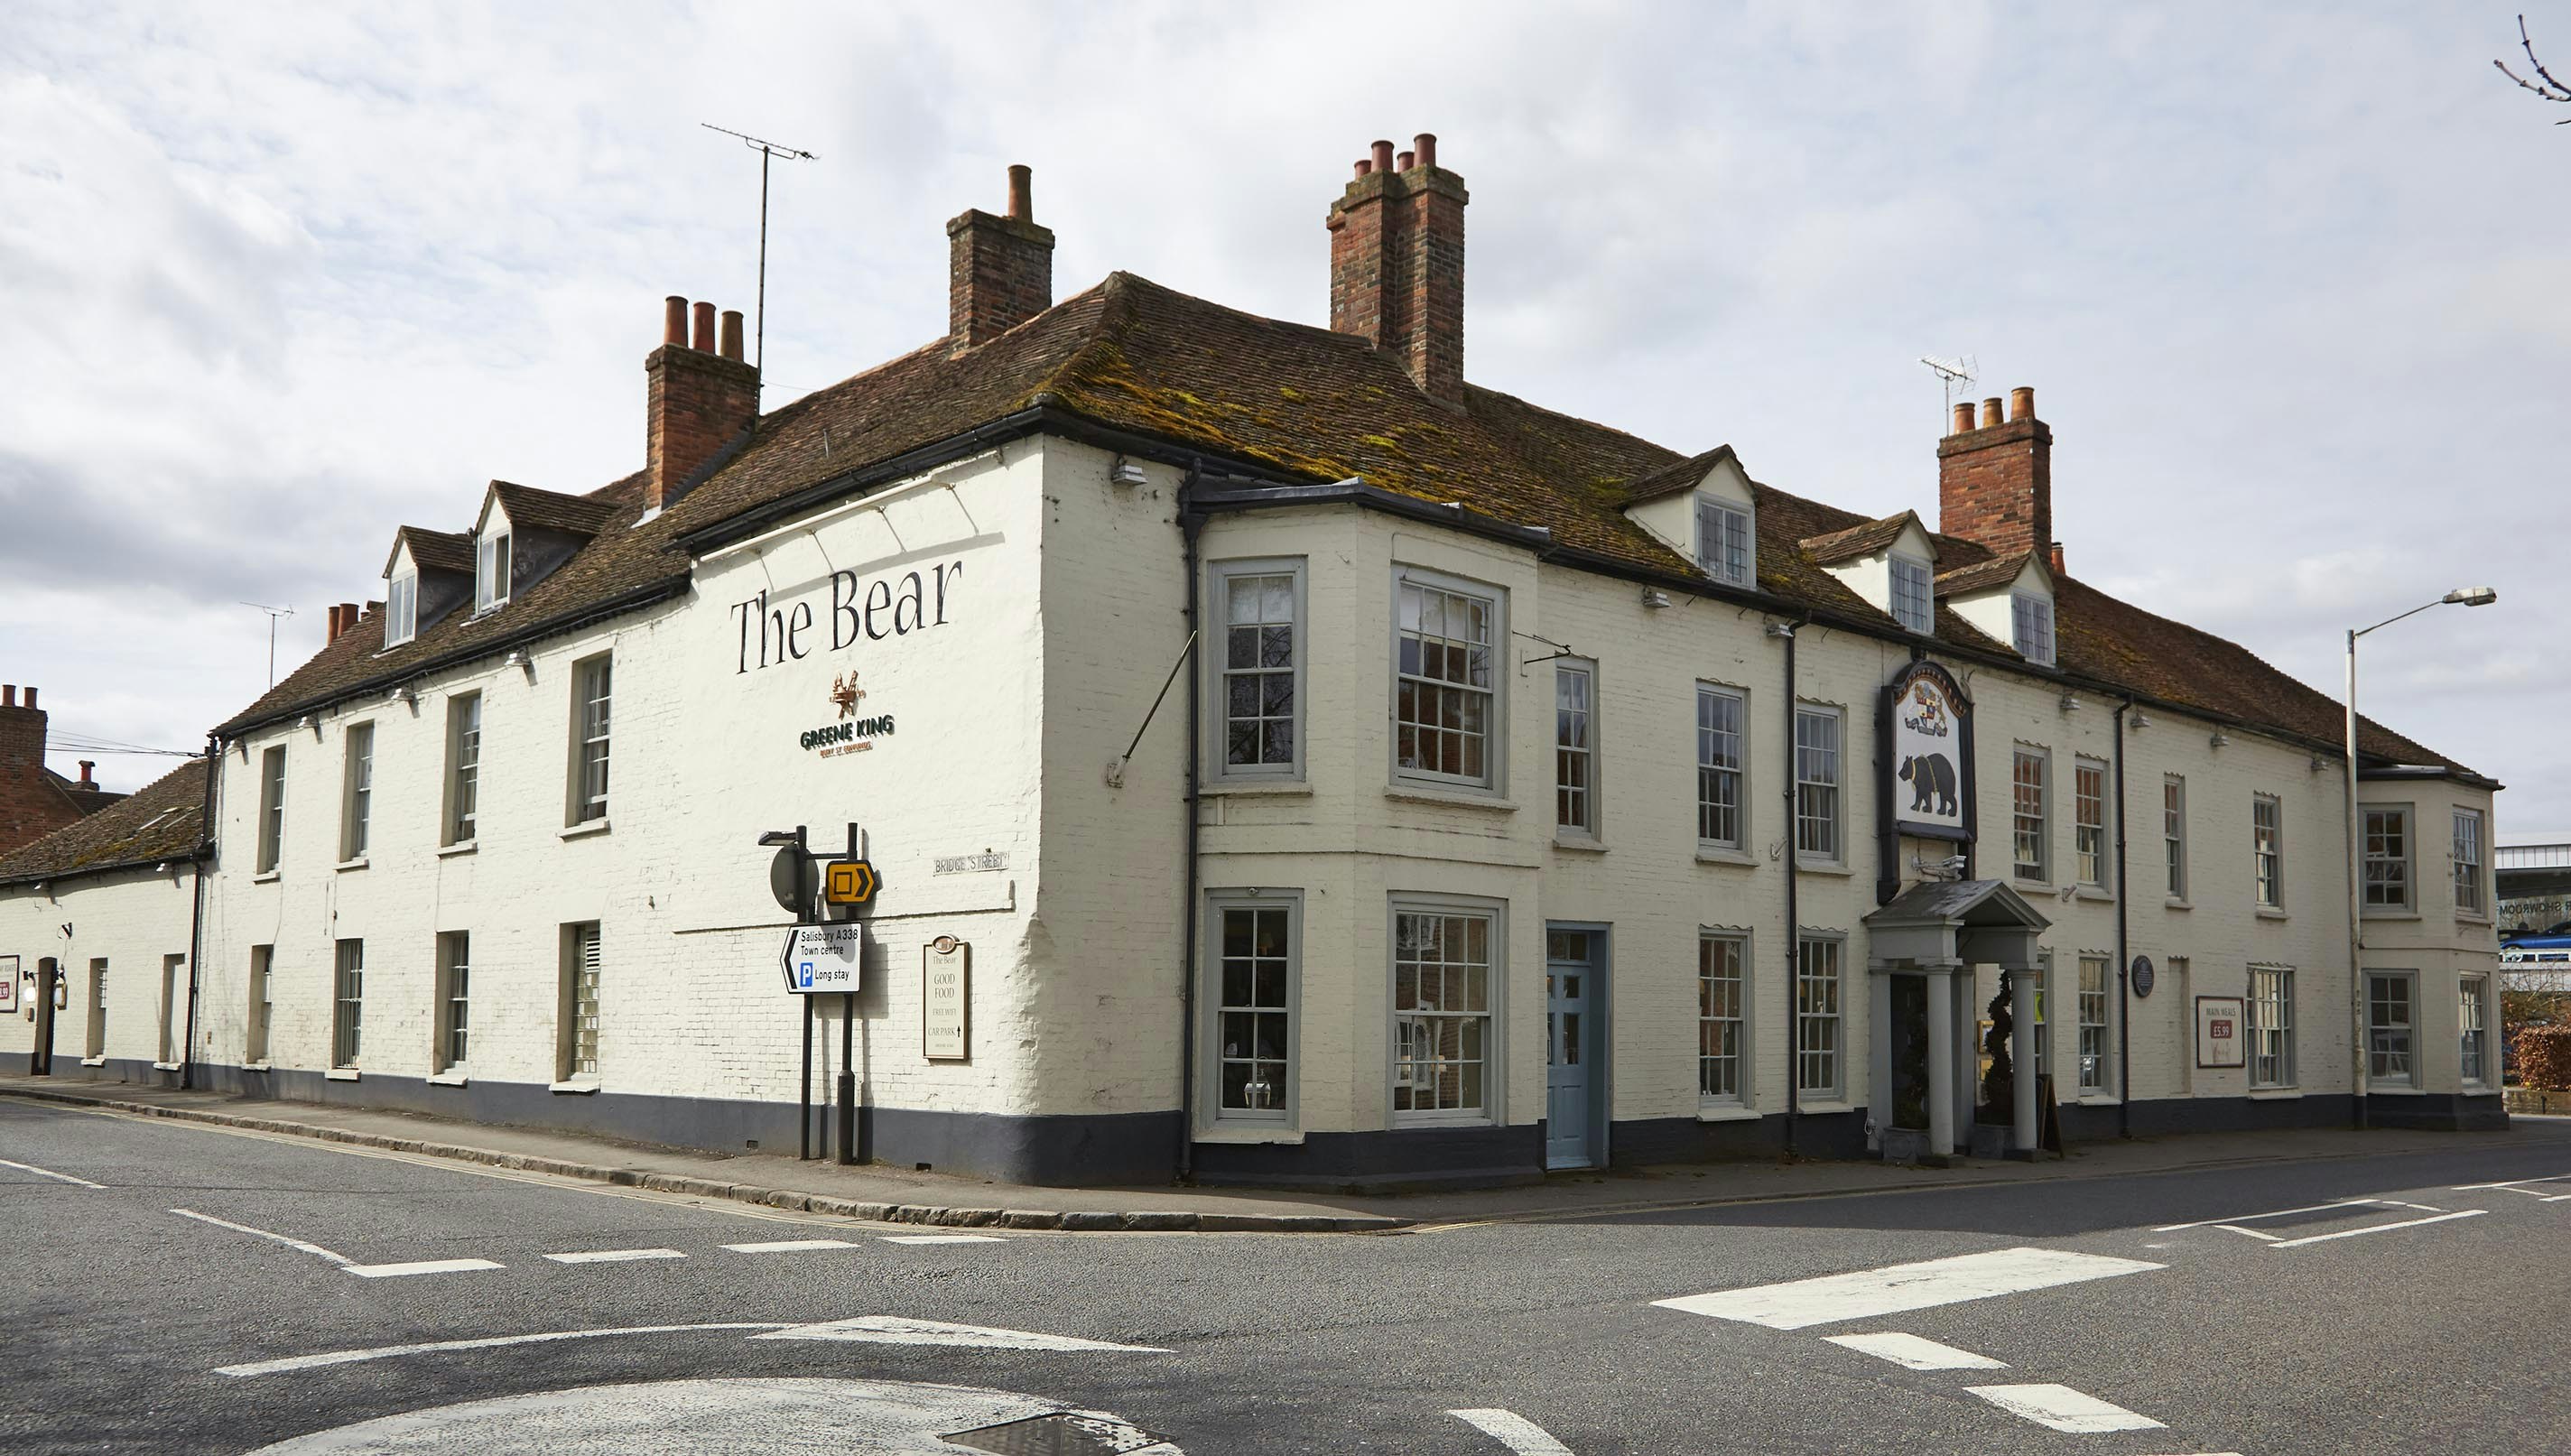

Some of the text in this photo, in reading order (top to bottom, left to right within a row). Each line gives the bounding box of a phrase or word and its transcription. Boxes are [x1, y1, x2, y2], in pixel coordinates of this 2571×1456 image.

[730, 561, 962, 674] The Bear
[800, 714, 894, 749] GREENE KING
[935, 851, 1005, 873] BRIDGE STREET
[801, 929, 859, 942] Salisbury A338
[801, 945, 844, 955] Town centre
[933, 956, 957, 964] The Bear
[815, 969, 831, 981] Long
[834, 969, 849, 981] stay
[934, 973, 955, 984] GOOD
[935, 988, 954, 998] FOOD
[928, 1027, 956, 1036] CAR PARK
[2214, 1025, 2230, 1037] £5.99
